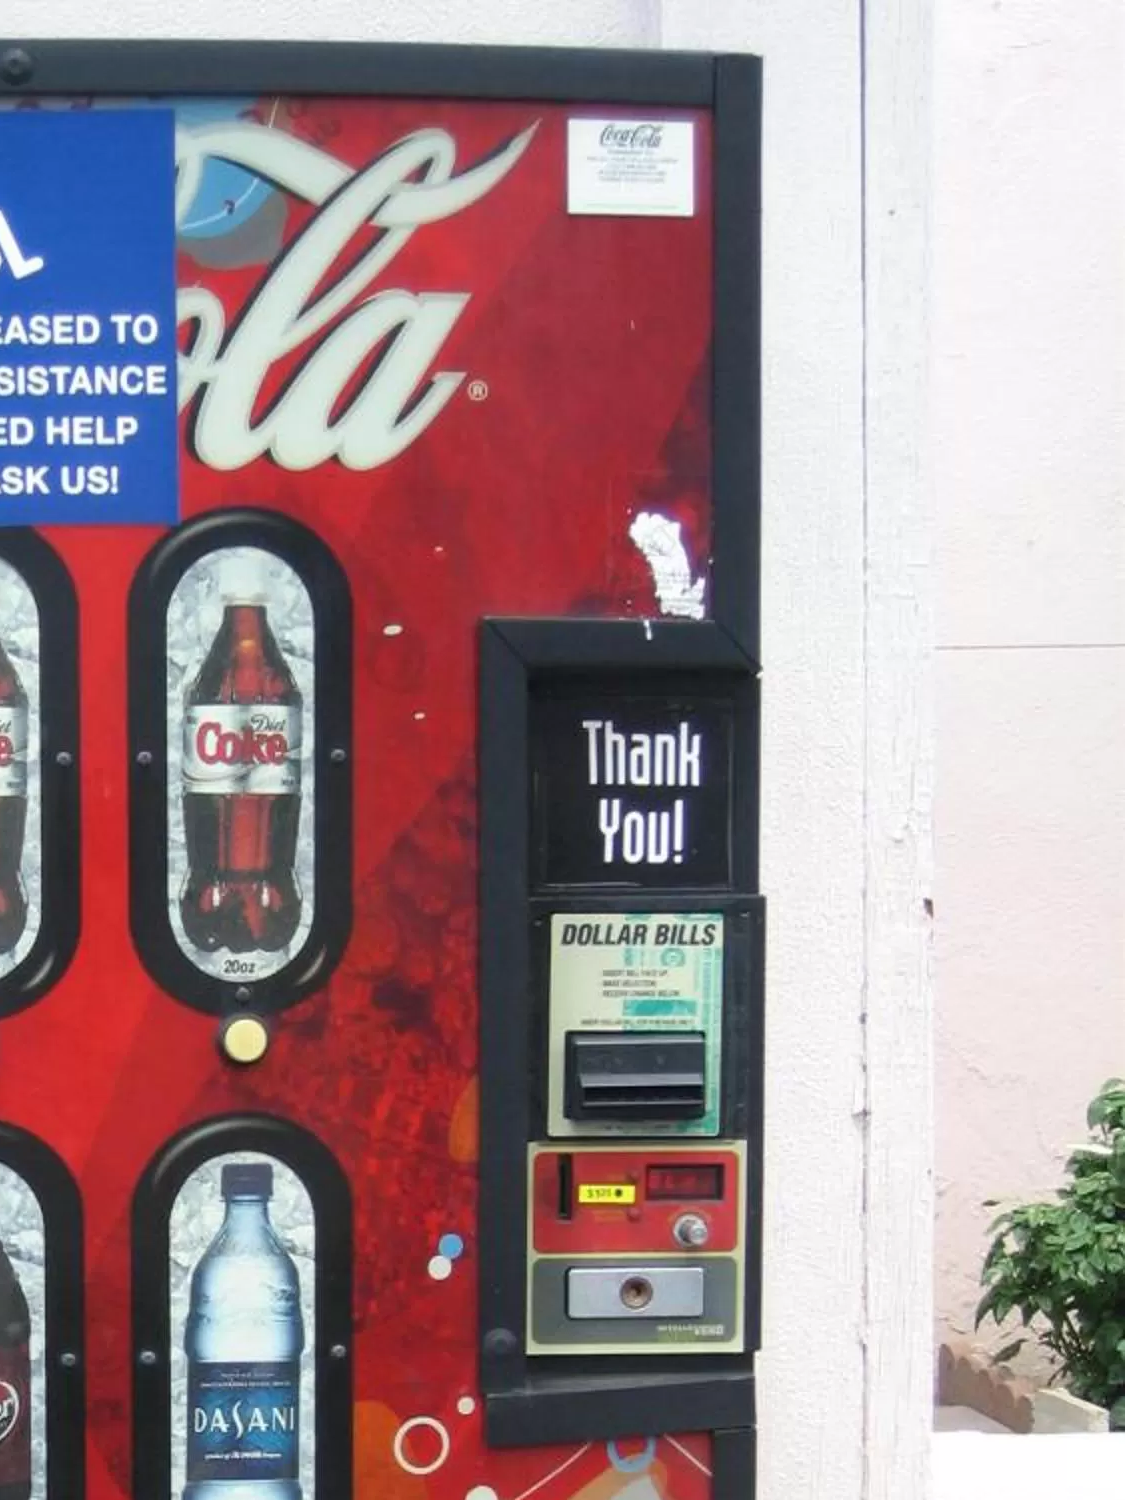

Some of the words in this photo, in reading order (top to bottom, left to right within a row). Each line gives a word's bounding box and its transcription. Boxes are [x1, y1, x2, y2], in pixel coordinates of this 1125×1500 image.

[112, 314, 159, 344] TO
[46, 416, 139, 445] HELP
[61, 465, 119, 494] US!
[250, 714, 287, 732] Diet
[196, 721, 288, 766] Coke
[582, 719, 702, 787] Thank
[598, 798, 684, 864] You!
[561, 923, 648, 946] DOLLAR
[654, 923, 716, 946] BILLS
[223, 958, 255, 974] 20oz
[194, 1400, 294, 1439] DASANI
